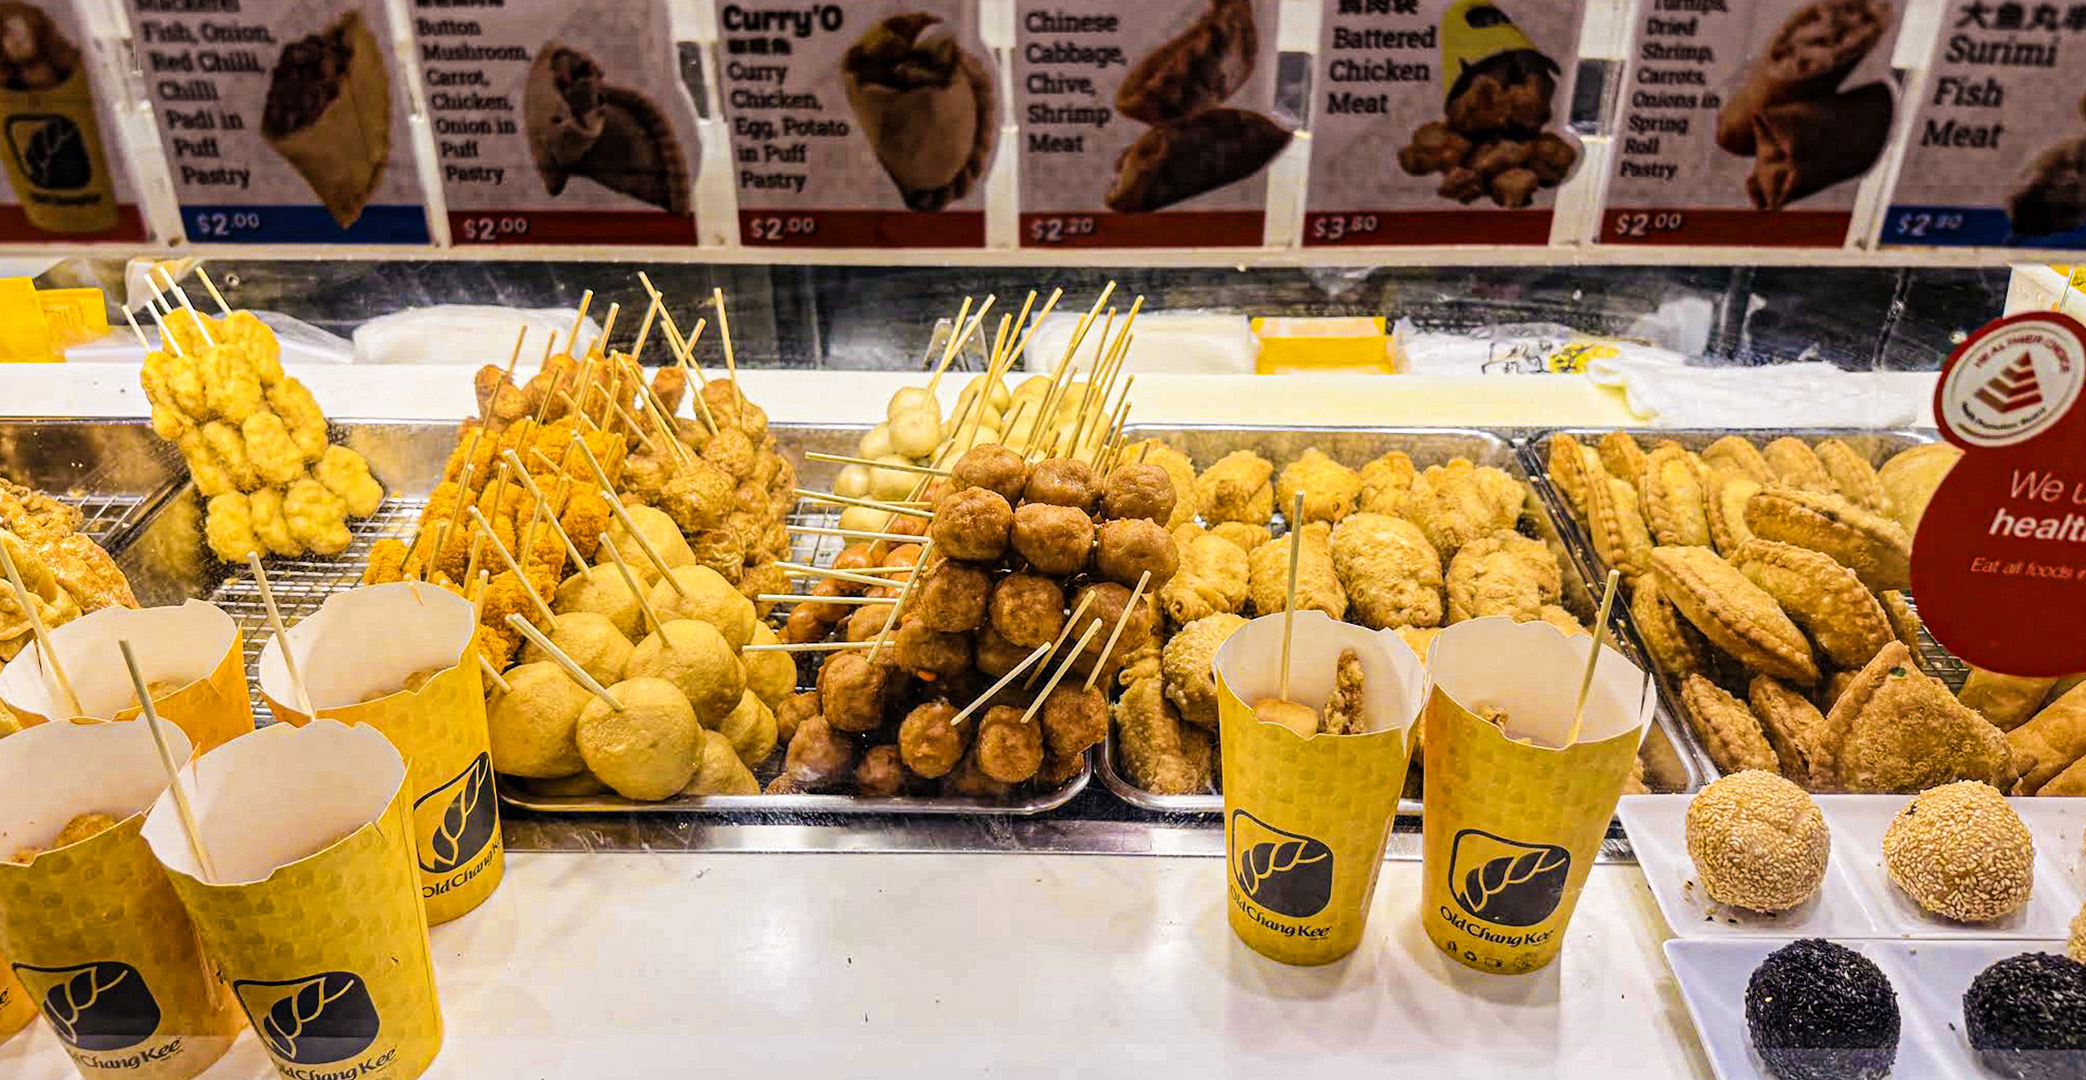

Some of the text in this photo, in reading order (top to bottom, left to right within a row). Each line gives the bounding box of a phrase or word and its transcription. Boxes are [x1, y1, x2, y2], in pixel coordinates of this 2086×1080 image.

[417, 18, 482, 36] Button
[723, 4, 843, 38] Curry'O
[1025, 12, 1118, 33] Chinese
[1647, 17, 1698, 36] Dried
[200, 21, 276, 44] Onion,
[1332, 25, 1437, 49] Battered
[421, 44, 532, 61] Mushroom,
[1026, 42, 1126, 68] Cabbage,
[1945, 34, 2061, 68] Surimi
[150, 50, 266, 76] Red Chilli,
[727, 62, 788, 85] Curry
[1329, 58, 1430, 82] Chicken
[426, 69, 490, 87] Carrot,
[1027, 73, 1096, 97] Chive,
[157, 81, 219, 101] Chilli
[731, 89, 823, 111] Chicken,
[1632, 91, 1720, 109] Onions in
[1933, 77, 2004, 107] Fish
[431, 93, 514, 112] Chicken,
[1327, 93, 1388, 114] Meat
[165, 109, 245, 130] Padi in
[435, 117, 517, 135] Onion in
[1027, 103, 1111, 127] Shrimp
[1628, 114, 1688, 136] Spring
[735, 116, 849, 140] Egg, Potato
[1921, 119, 2004, 147] Meat
[172, 137, 220, 158] Puff
[441, 141, 479, 159] Puff
[738, 144, 808, 163] in Puff
[1028, 133, 1084, 153] Meat
[1624, 138, 1660, 154] Roll
[181, 165, 251, 189] Pastry
[446, 165, 504, 185] Pastry
[741, 170, 807, 193] Pastry
[1620, 161, 1678, 181] Pastry
[2011, 469, 2064, 503] We
[1970, 557, 1999, 574] Eat
[1246, 906, 1296, 937] Chang
[1298, 925, 1331, 937] Kee
[1440, 905, 1467, 931] Old
[1466, 923, 1522, 947] Chang
[80, 1054, 141, 1069] Chang
[140, 1039, 180, 1063] Kee
[358, 1048, 396, 1074] Kee
